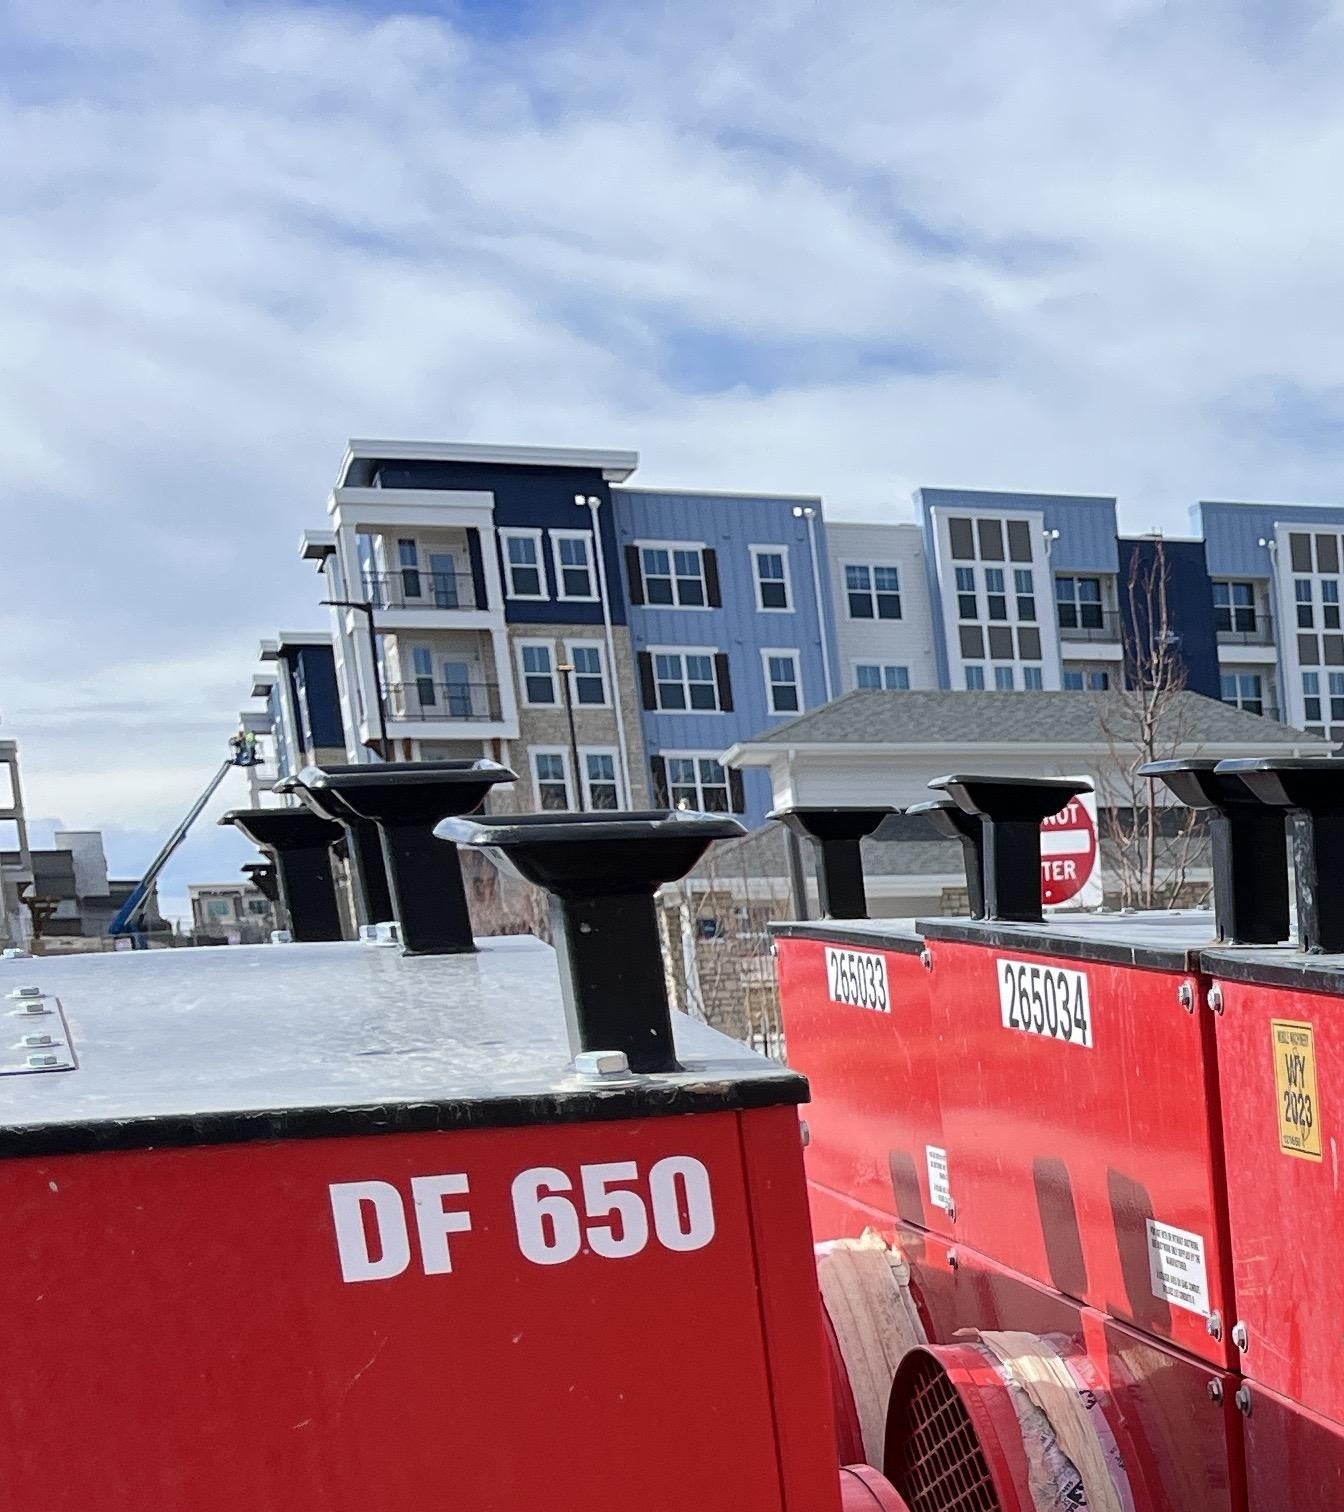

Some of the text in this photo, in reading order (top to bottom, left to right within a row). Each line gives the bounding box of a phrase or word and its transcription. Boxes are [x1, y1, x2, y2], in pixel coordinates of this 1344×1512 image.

[1041, 860, 1077, 882] TER
[831, 951, 887, 1011] 265033
[1004, 962, 1088, 1045] 265034
[1284, 1052, 1306, 1089] WY
[1283, 1089, 1313, 1128] 2023
[327, 1155, 715, 1284] DF 650
